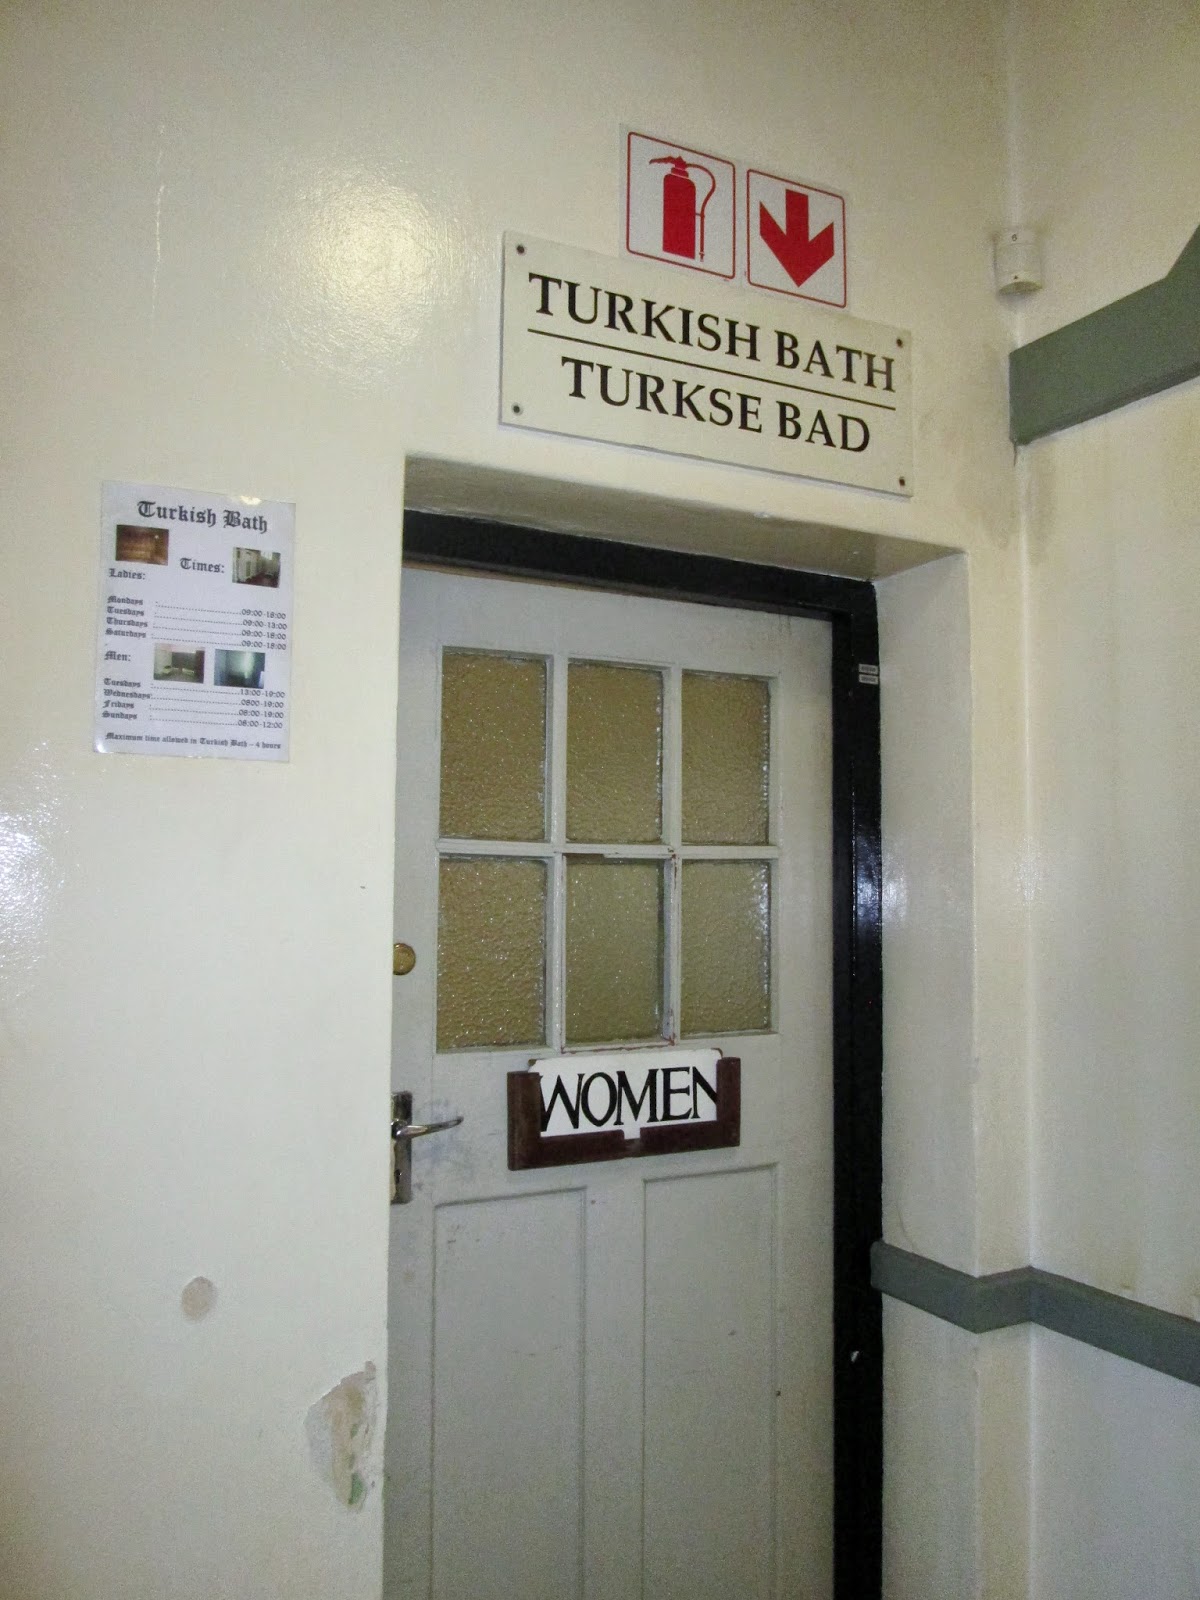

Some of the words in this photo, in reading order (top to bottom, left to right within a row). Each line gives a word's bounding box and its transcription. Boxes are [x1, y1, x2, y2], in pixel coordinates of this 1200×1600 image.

[528, 272, 761, 362] TURKISH
[774, 330, 896, 393] BATH
[561, 356, 763, 434] TURKSE
[776, 400, 871, 453] BAD
[137, 500, 217, 527] Turkish
[223, 509, 268, 534] Bath
[179, 557, 225, 573] Times:
[109, 568, 146, 580] Ladies:
[107, 595, 144, 605] Mondays
[106, 606, 145, 616] Tuesdays
[106, 617, 148, 628] Thursdays
[105, 628, 147, 638] Saturdays
[104, 650, 131, 661] Men:
[103, 677, 141, 688] Tuesdays
[103, 688, 151, 700] Wednesdays
[102, 700, 135, 710] Fridays
[102, 710, 138, 721] Sundays
[105, 732, 143, 741] Maximum
[145, 734, 160, 743] time
[162, 735, 188, 744] allowed
[199, 737, 229, 747] Turkish
[230, 739, 248, 748] Bath
[261, 741, 281, 749] hours
[540, 1066, 718, 1132] WOMEN
